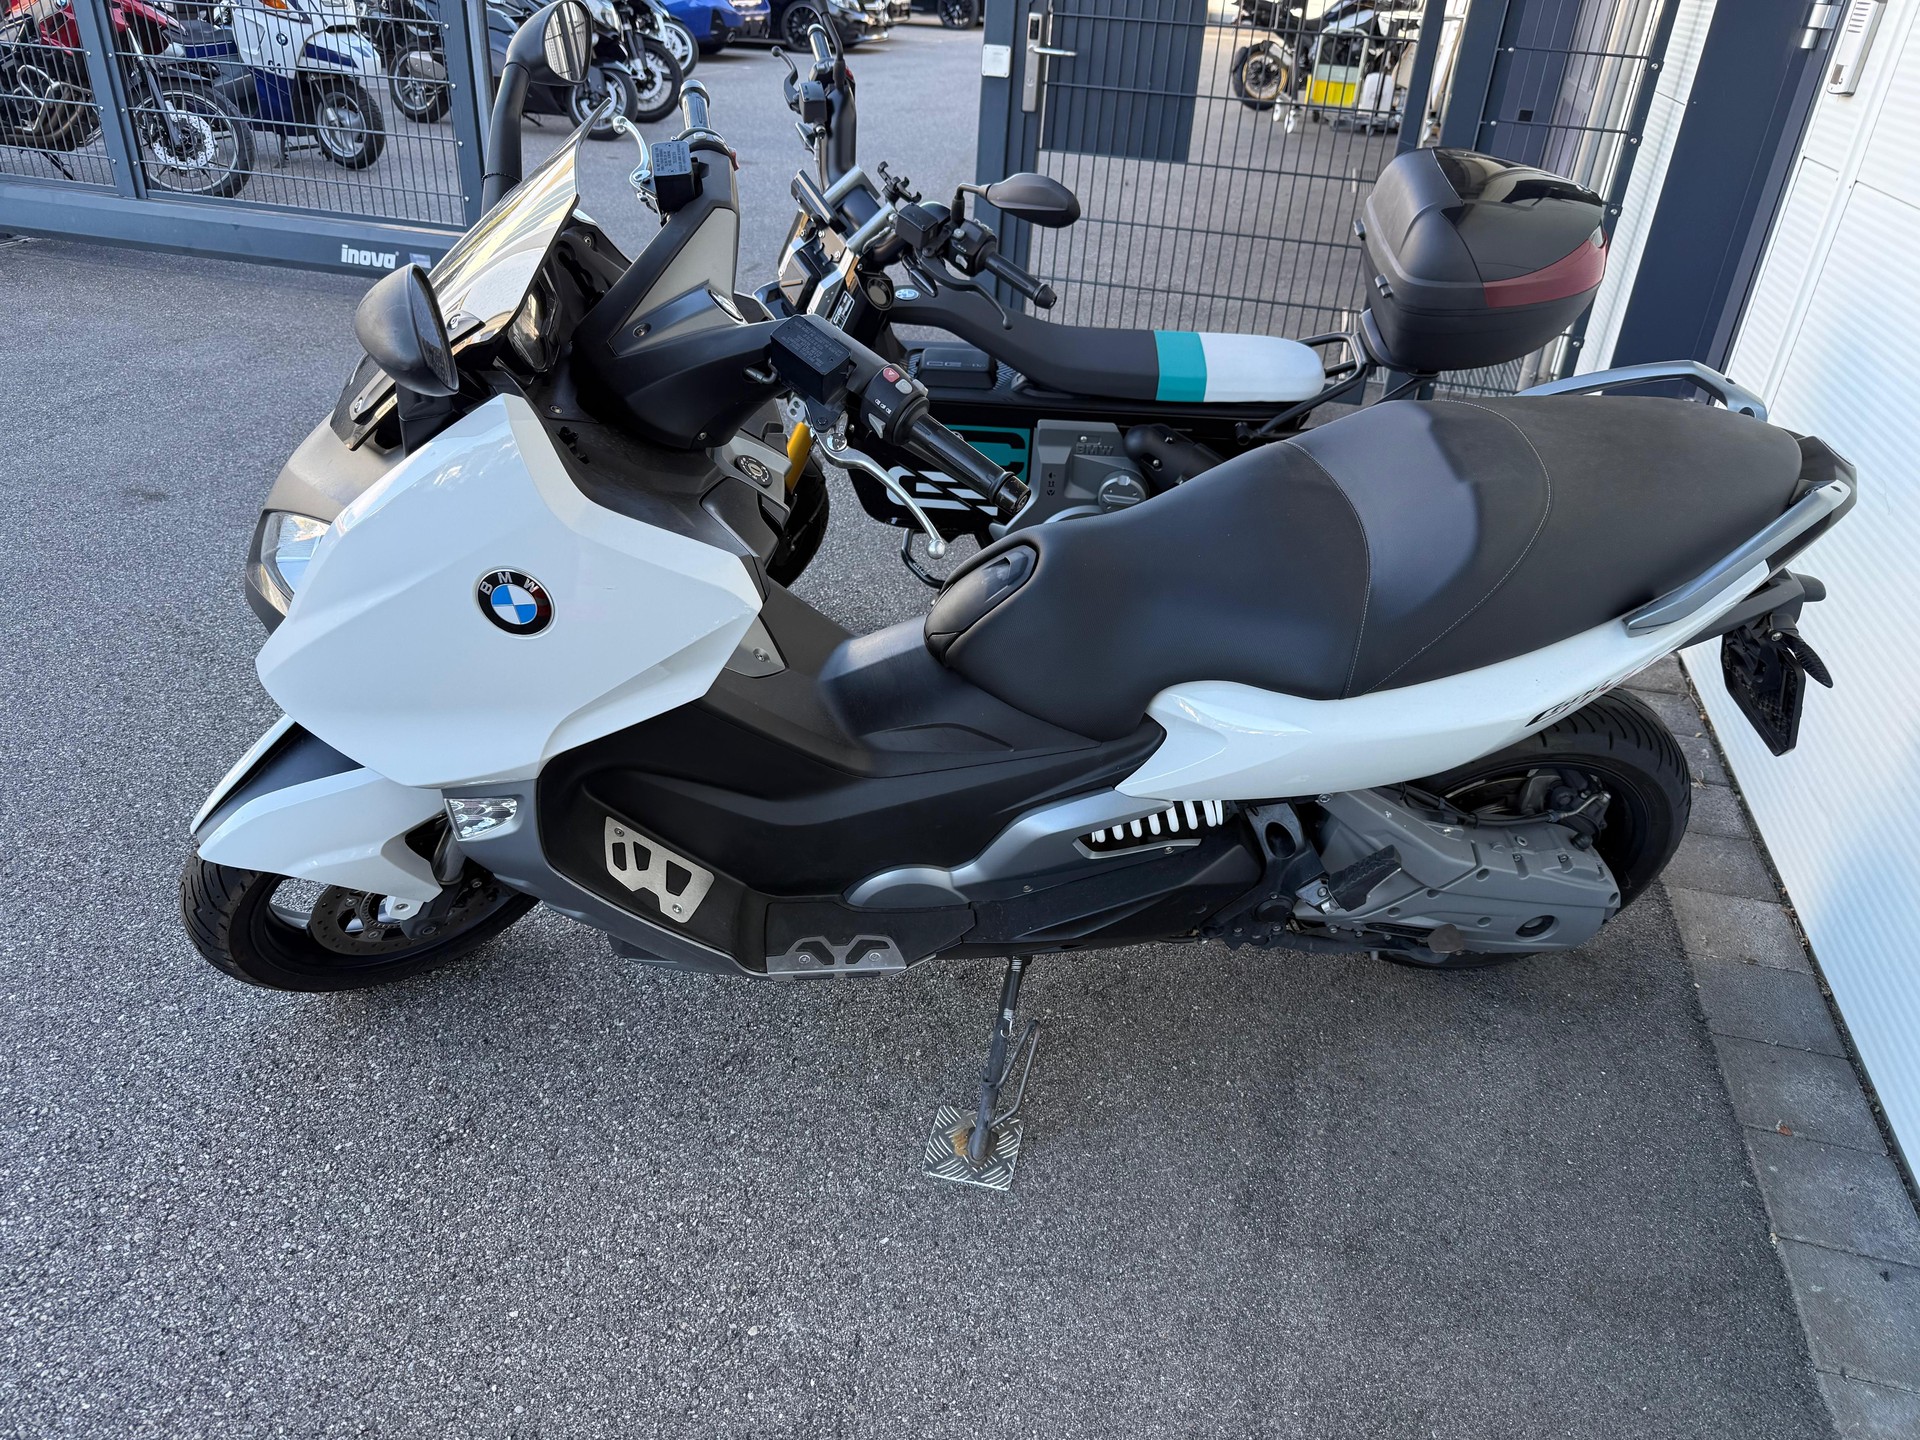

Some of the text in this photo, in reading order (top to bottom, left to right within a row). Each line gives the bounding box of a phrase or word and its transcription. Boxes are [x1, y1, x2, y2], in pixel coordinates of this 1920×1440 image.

[341, 243, 396, 269] inova
[1075, 442, 1114, 456] BMW
[480, 571, 539, 596] BMW
